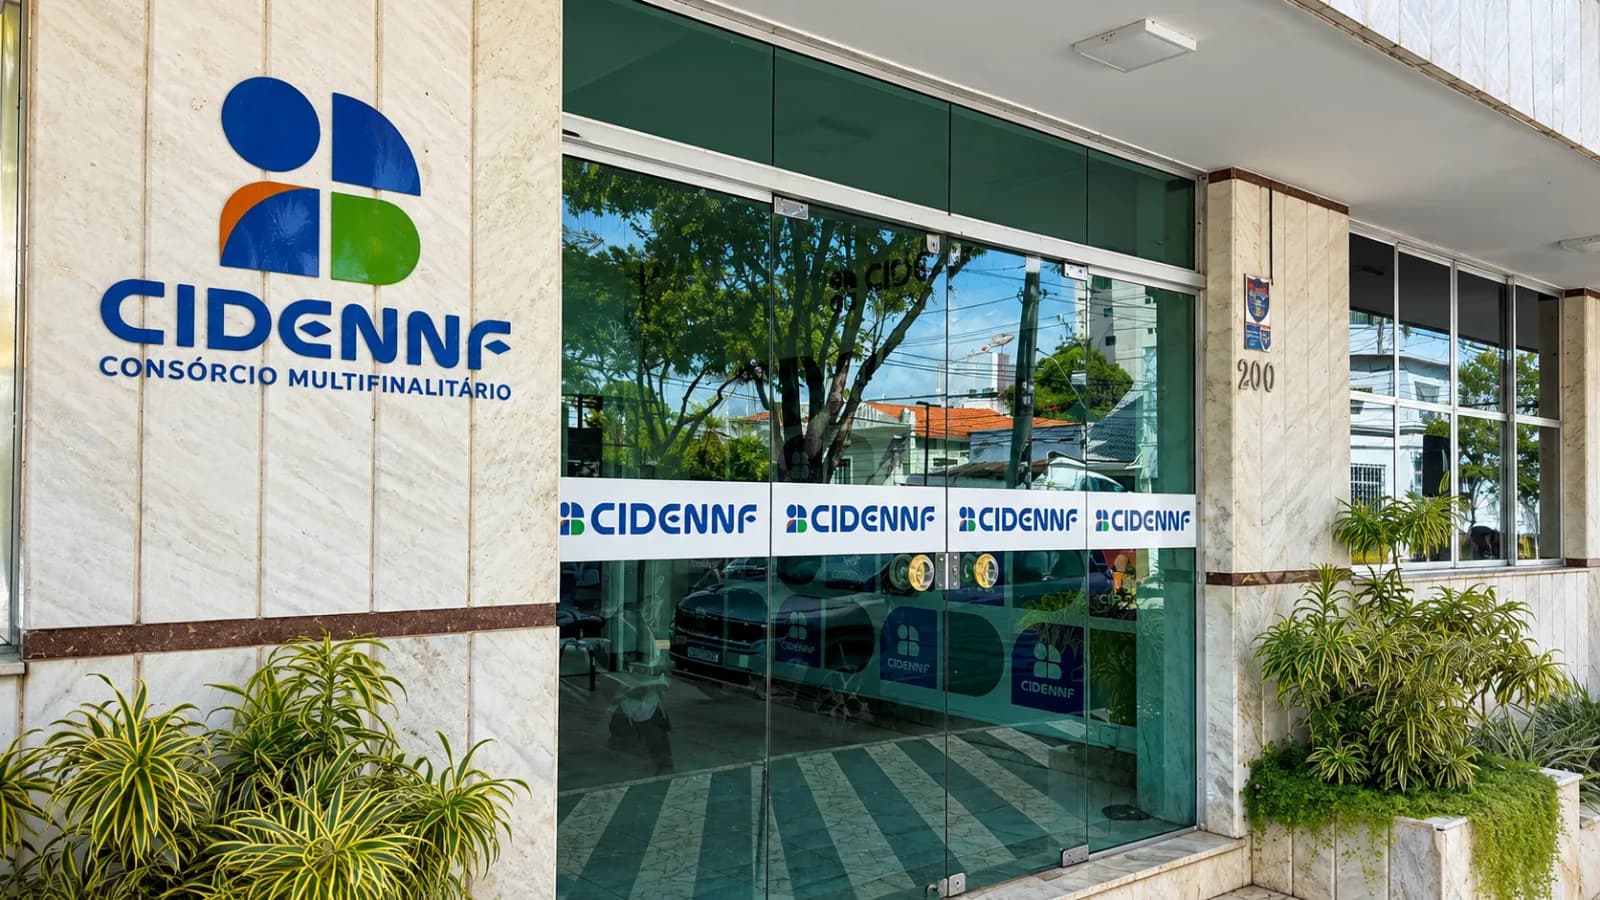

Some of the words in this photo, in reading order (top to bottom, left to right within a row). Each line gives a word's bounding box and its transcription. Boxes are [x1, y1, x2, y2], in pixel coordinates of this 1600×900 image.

[100, 278, 511, 371] CIDENNF
[99, 355, 278, 386] CONSÓRCIO
[288, 367, 512, 401] MULTIFINALITÁRIO
[1237, 358, 1275, 393] 200
[590, 502, 757, 535] CIDENNF
[811, 504, 936, 534] CIDENNF
[979, 507, 1078, 532] CIDENNF
[1111, 509, 1191, 532] CIDENNF
[887, 656, 930, 673] CIDENNF
[1020, 679, 1076, 699] CIDENNF
